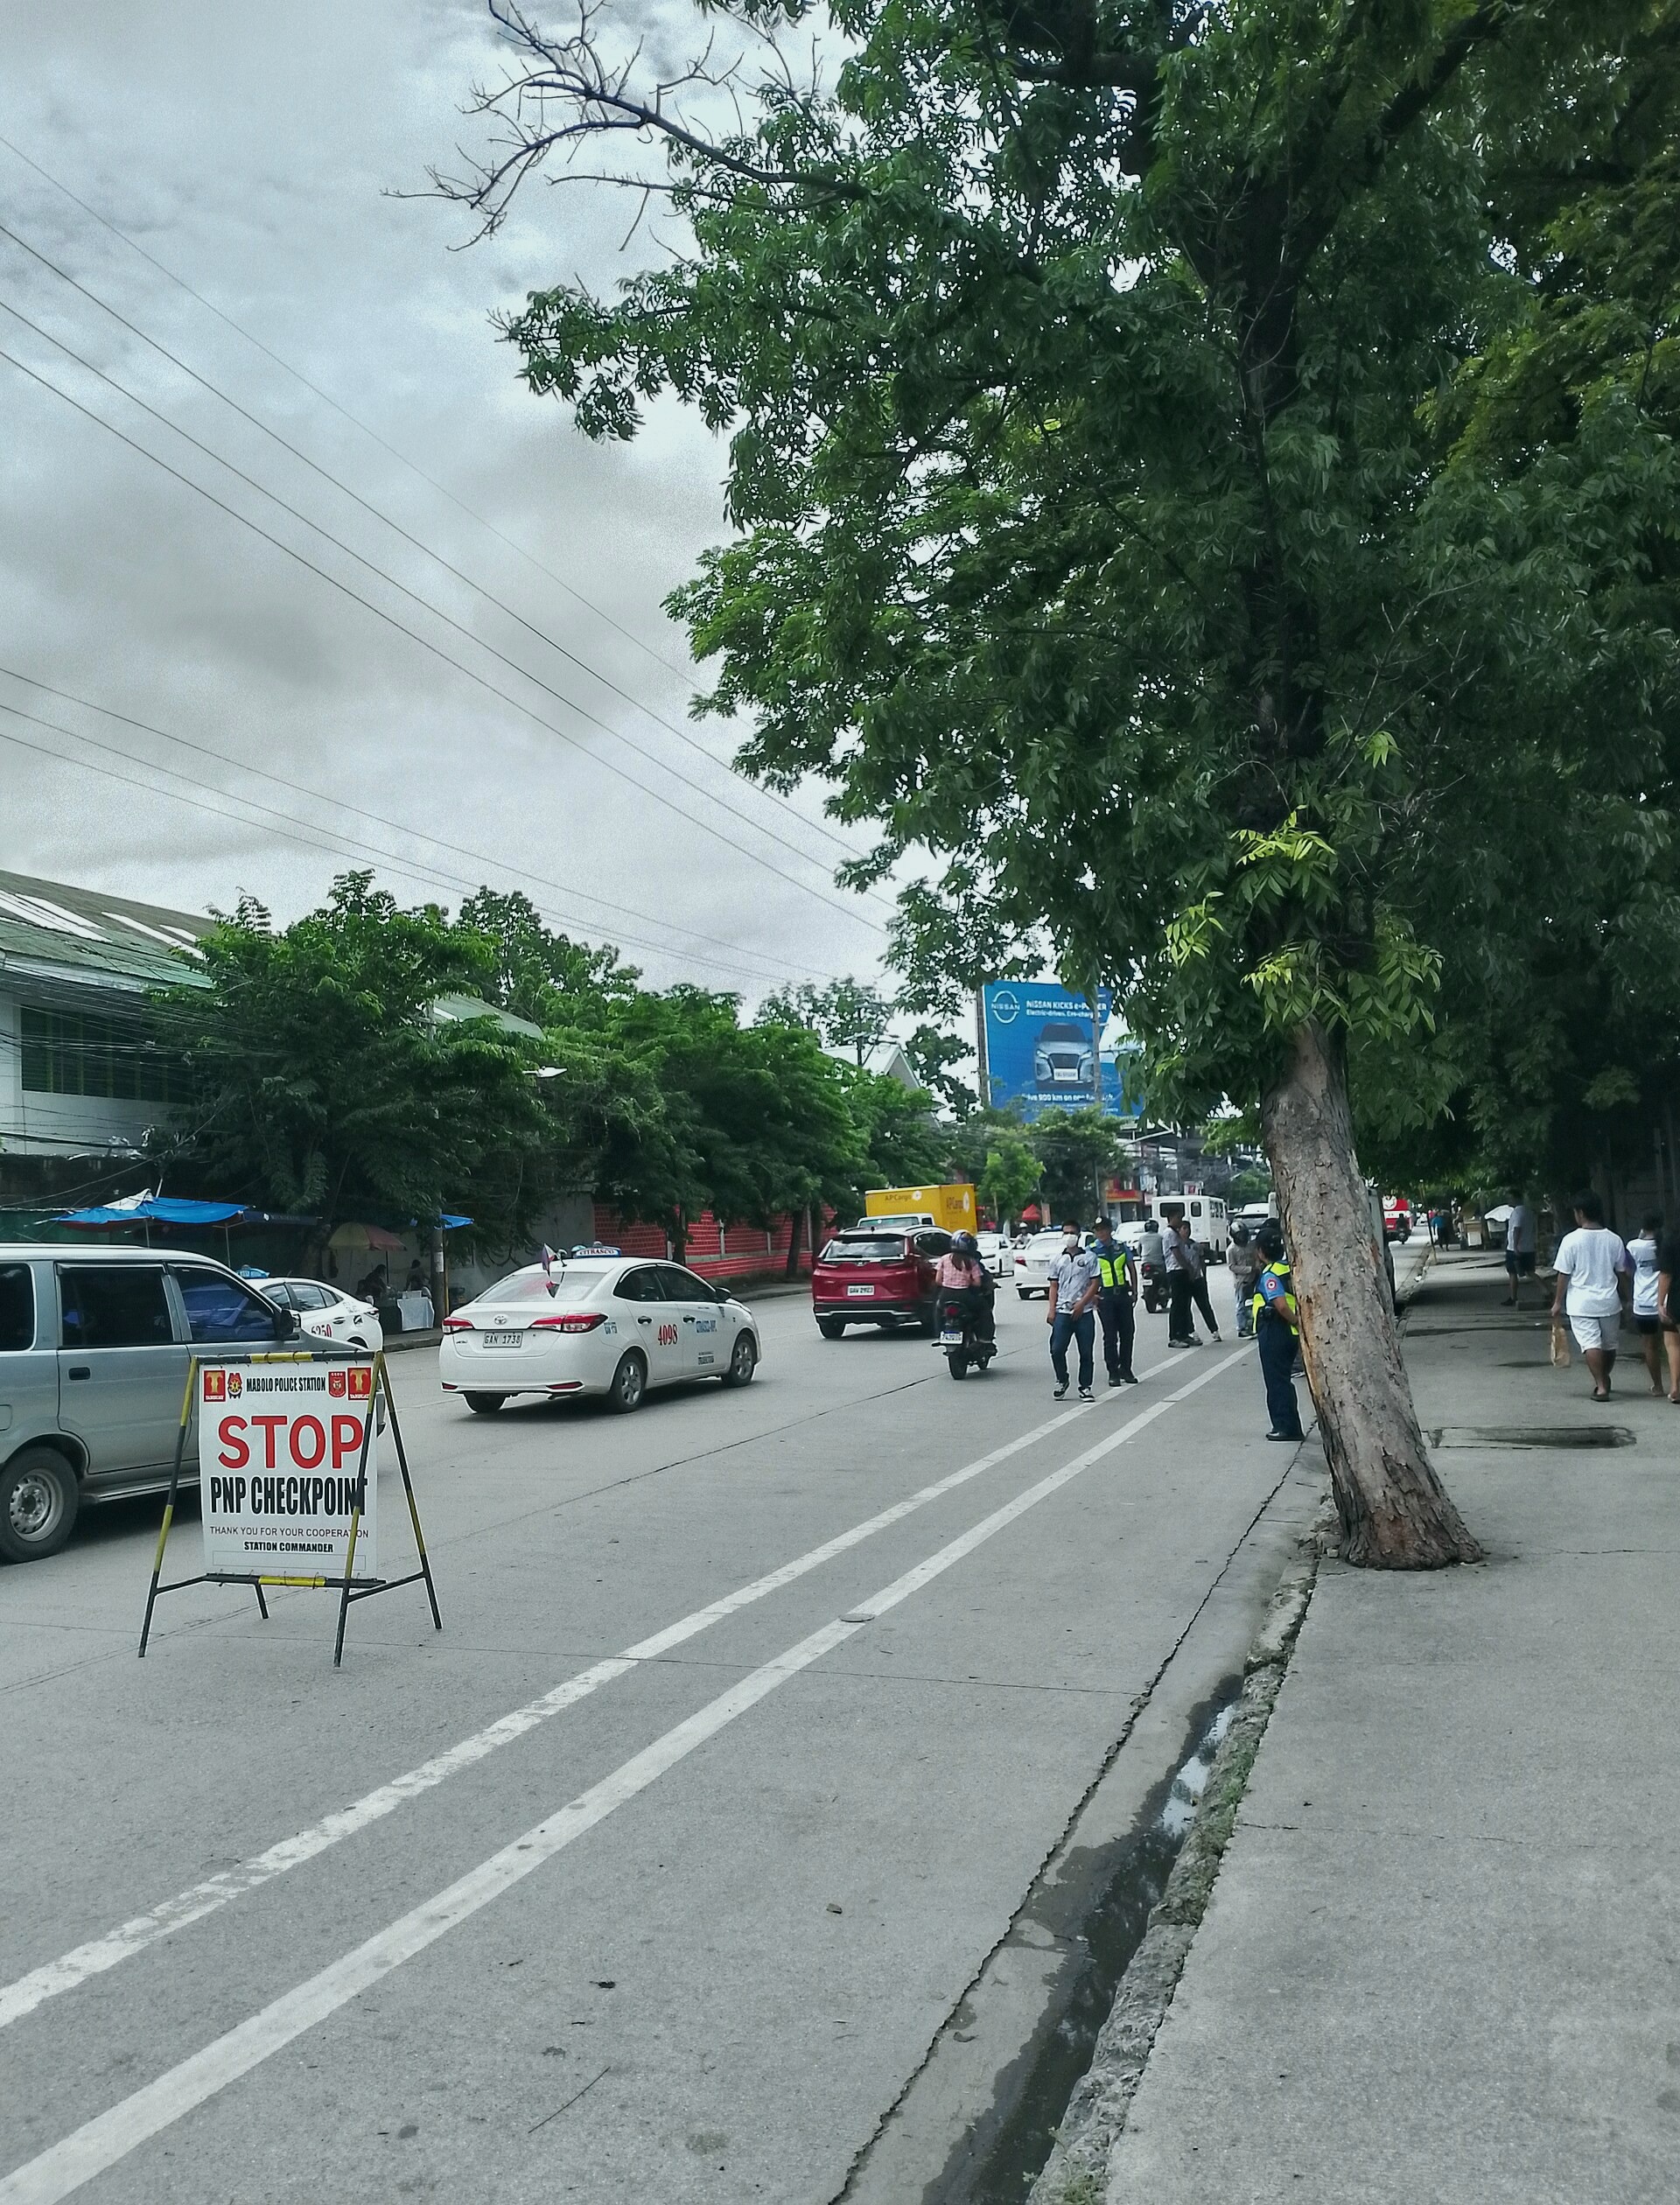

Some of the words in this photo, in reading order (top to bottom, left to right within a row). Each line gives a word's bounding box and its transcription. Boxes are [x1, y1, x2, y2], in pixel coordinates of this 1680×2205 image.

[1026, 1000, 1052, 1009] NISSAN
[1053, 1001, 1073, 1010] KICKS
[484, 1335, 499, 1345] GAN
[502, 1335, 522, 1345] 1738
[658, 1324, 678, 1346] 4098
[246, 1377, 273, 1392] MABOLO
[274, 1376, 298, 1392] POLICE
[298, 1376, 326, 1391] STATION
[218, 1415, 364, 1469] STOP
[210, 1476, 246, 1514] PNP
[251, 1476, 368, 1516] CHECKPOINT
[210, 1526, 238, 1536] THANK
[241, 1527, 258, 1536] YOU
[260, 1528, 277, 1536] FOR
[280, 1528, 304, 1537] YOUR
[306, 1530, 369, 1539] COOPERAON
[244, 1541, 277, 1551] STATION
[279, 1543, 333, 1553] COMMANDER
